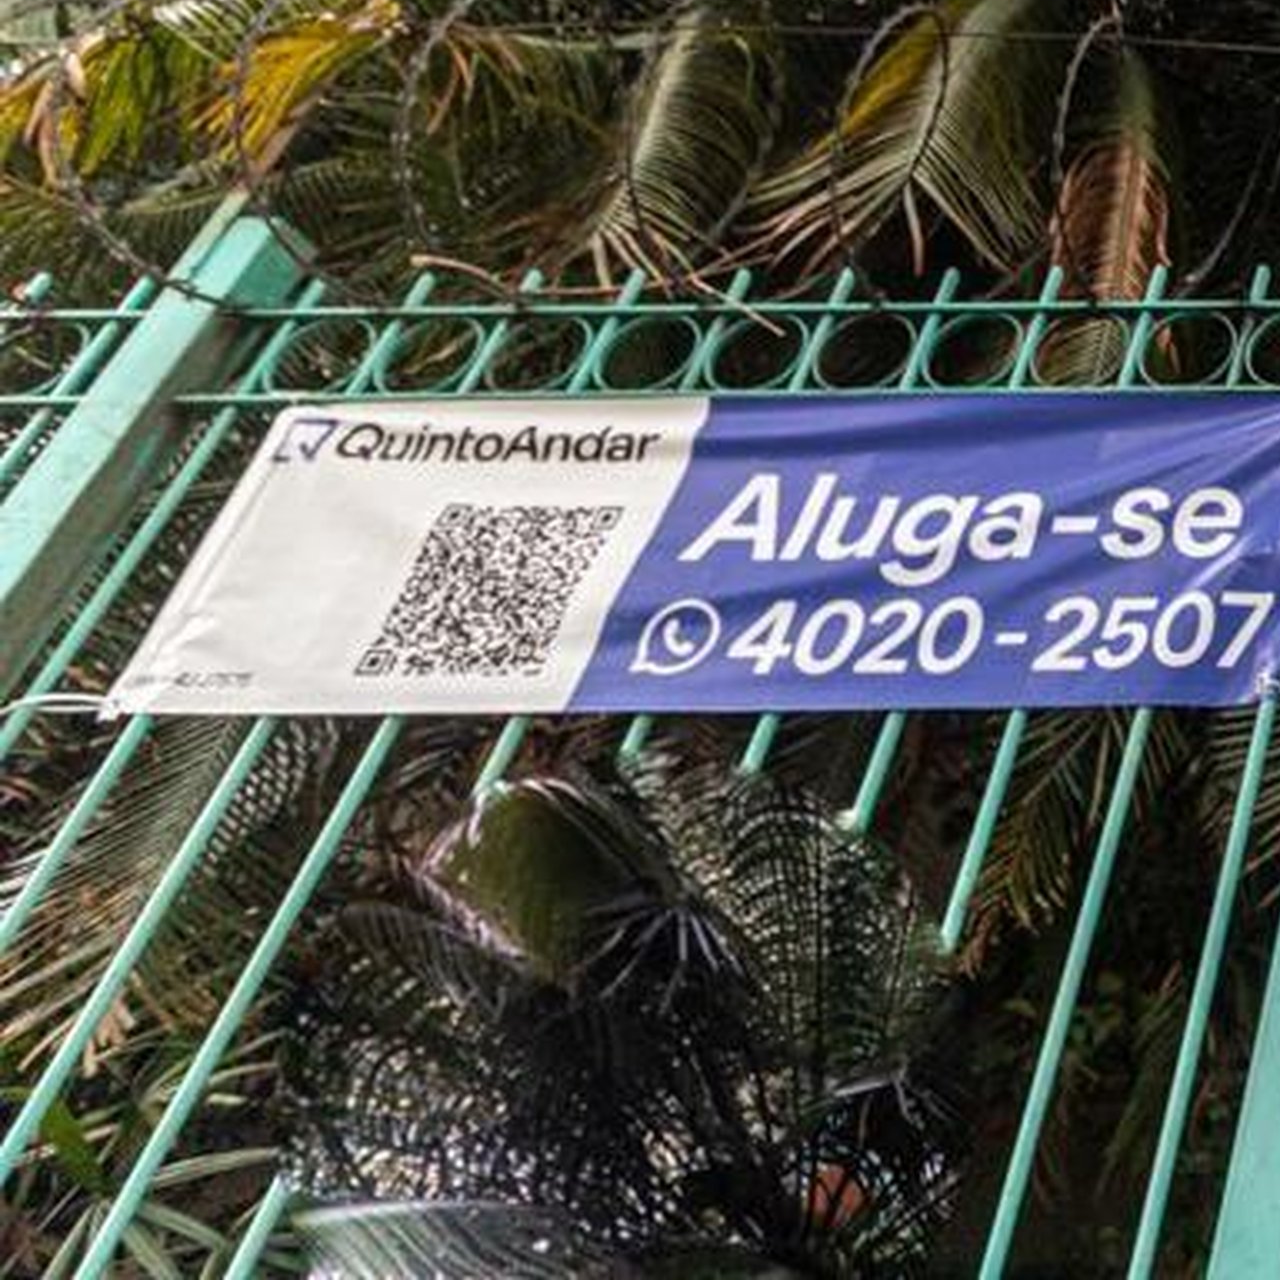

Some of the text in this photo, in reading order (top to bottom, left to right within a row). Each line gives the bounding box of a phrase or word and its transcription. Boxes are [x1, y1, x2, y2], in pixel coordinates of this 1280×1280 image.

[336, 422, 661, 463] QuintoAndar
[678, 473, 1245, 587] Aluga-se
[727, 591, 1275, 675] 4020-2507
